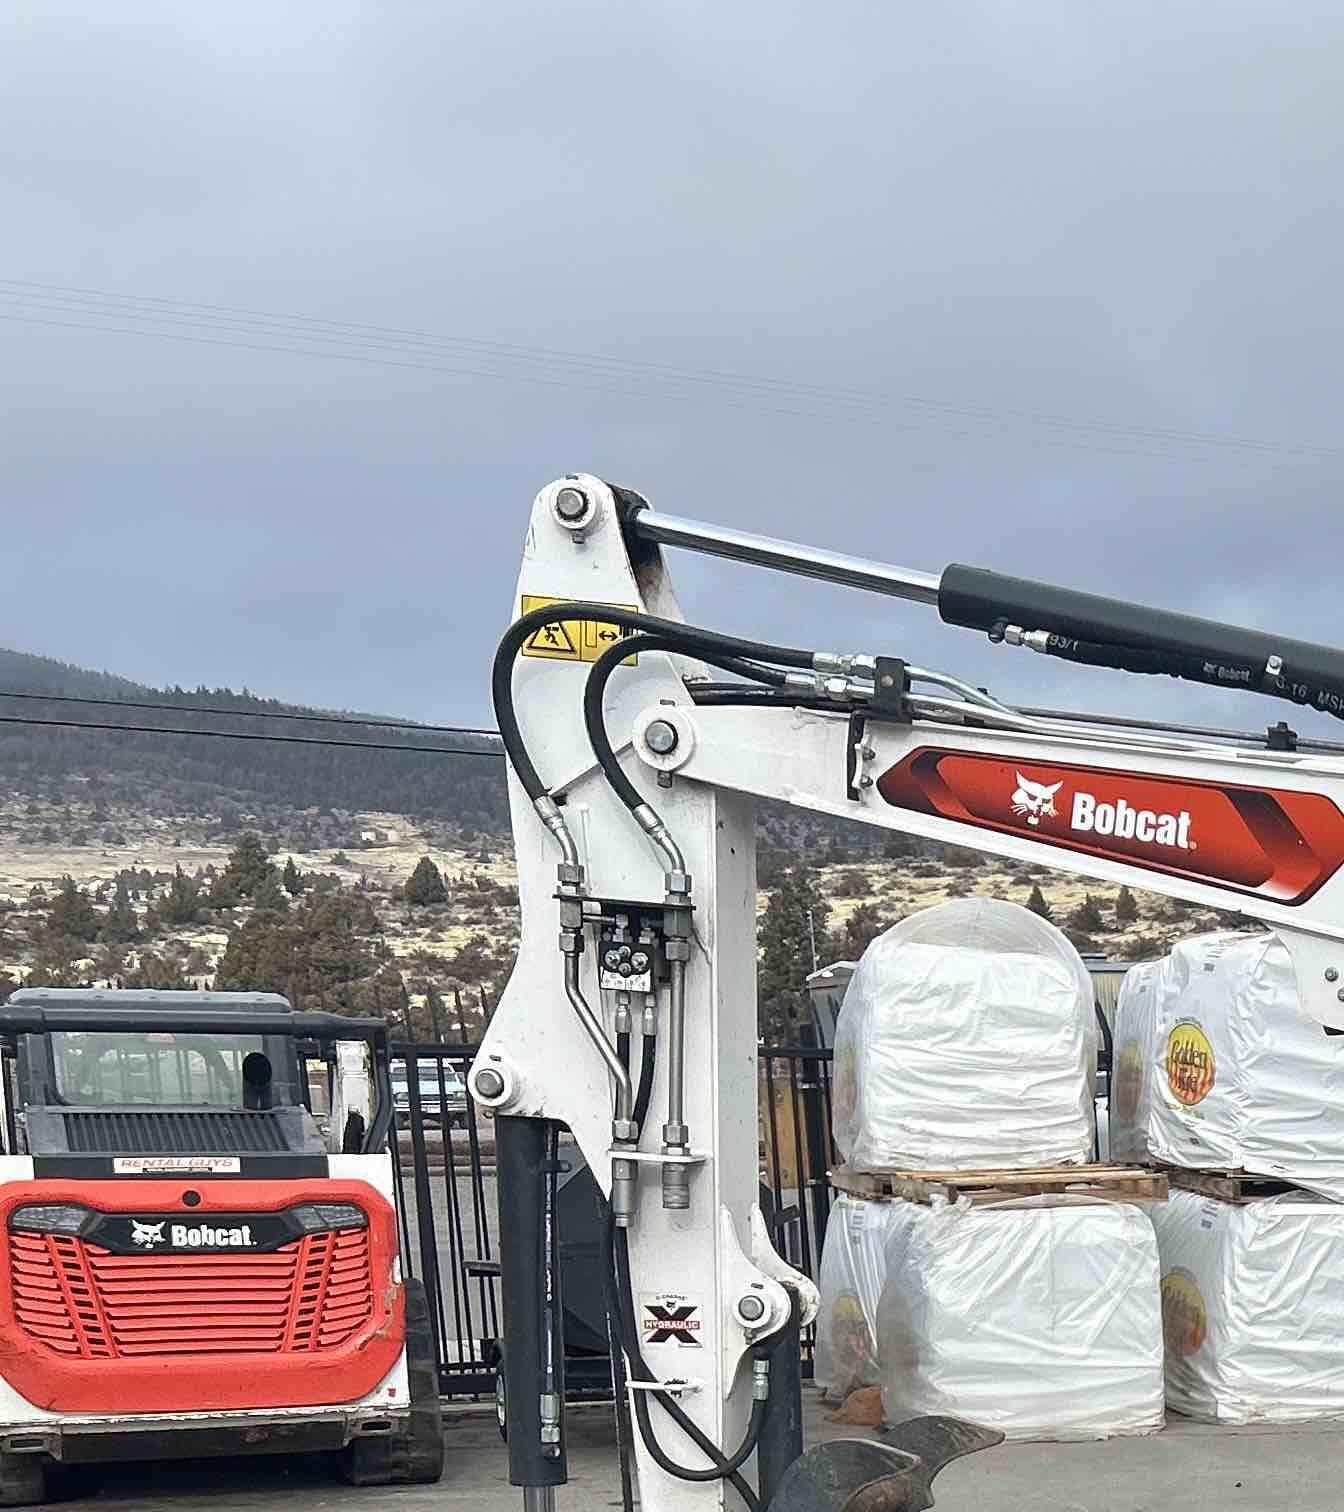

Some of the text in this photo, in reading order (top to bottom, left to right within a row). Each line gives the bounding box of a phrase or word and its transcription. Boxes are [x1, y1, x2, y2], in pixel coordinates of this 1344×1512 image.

[1071, 791, 1192, 849] Bobcat
[120, 1158, 233, 1168] RENTAL GUYS
[171, 1224, 252, 1247] Bobcat
